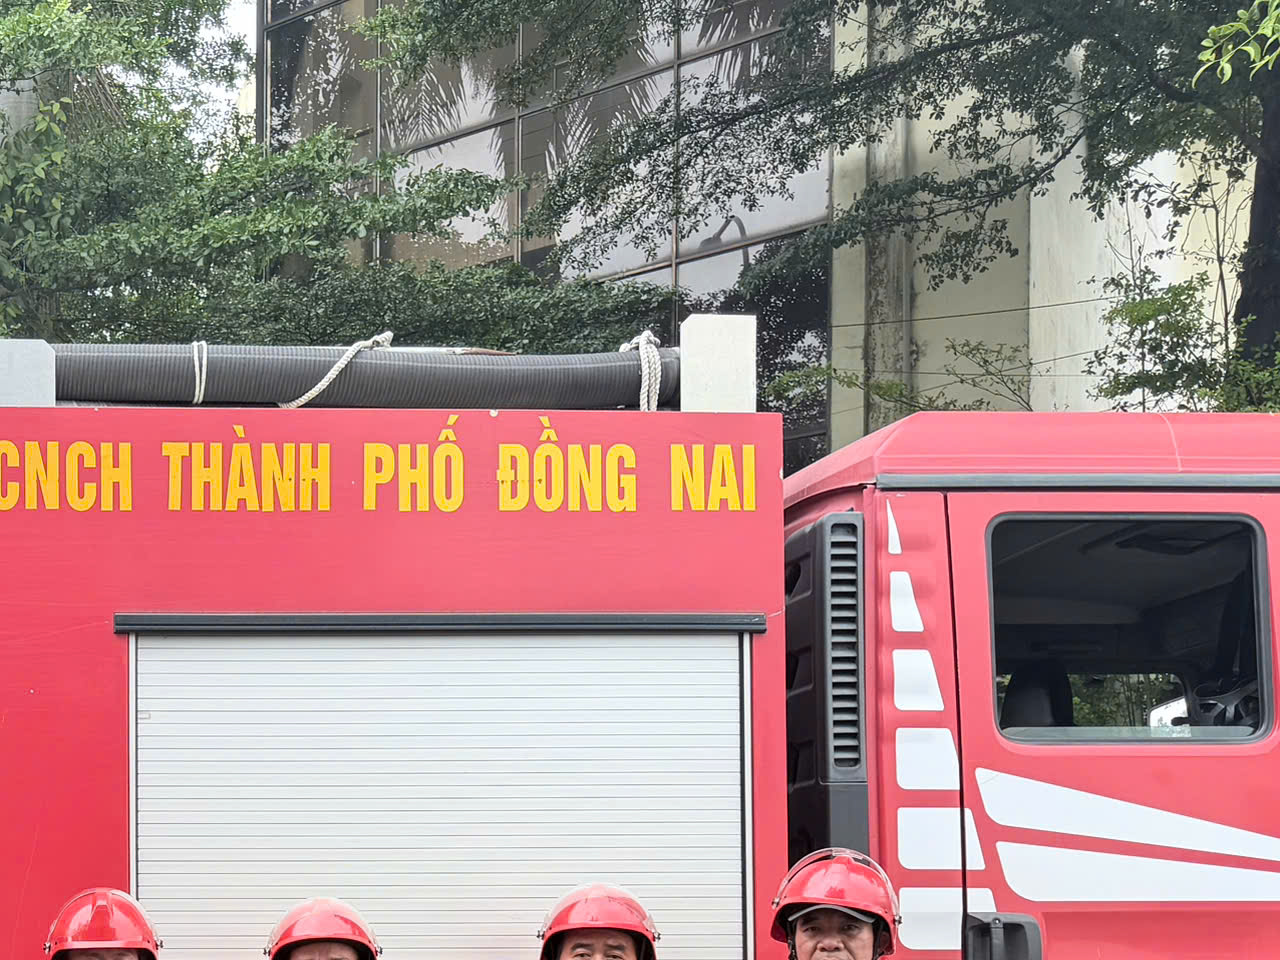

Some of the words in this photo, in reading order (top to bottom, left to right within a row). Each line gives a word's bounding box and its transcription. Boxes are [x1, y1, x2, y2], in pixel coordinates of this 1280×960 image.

[162, 425, 331, 513] THÀNH
[363, 415, 465, 513] PHỐ
[496, 416, 637, 513] ĐỒNG
[671, 444, 757, 513] NAI
